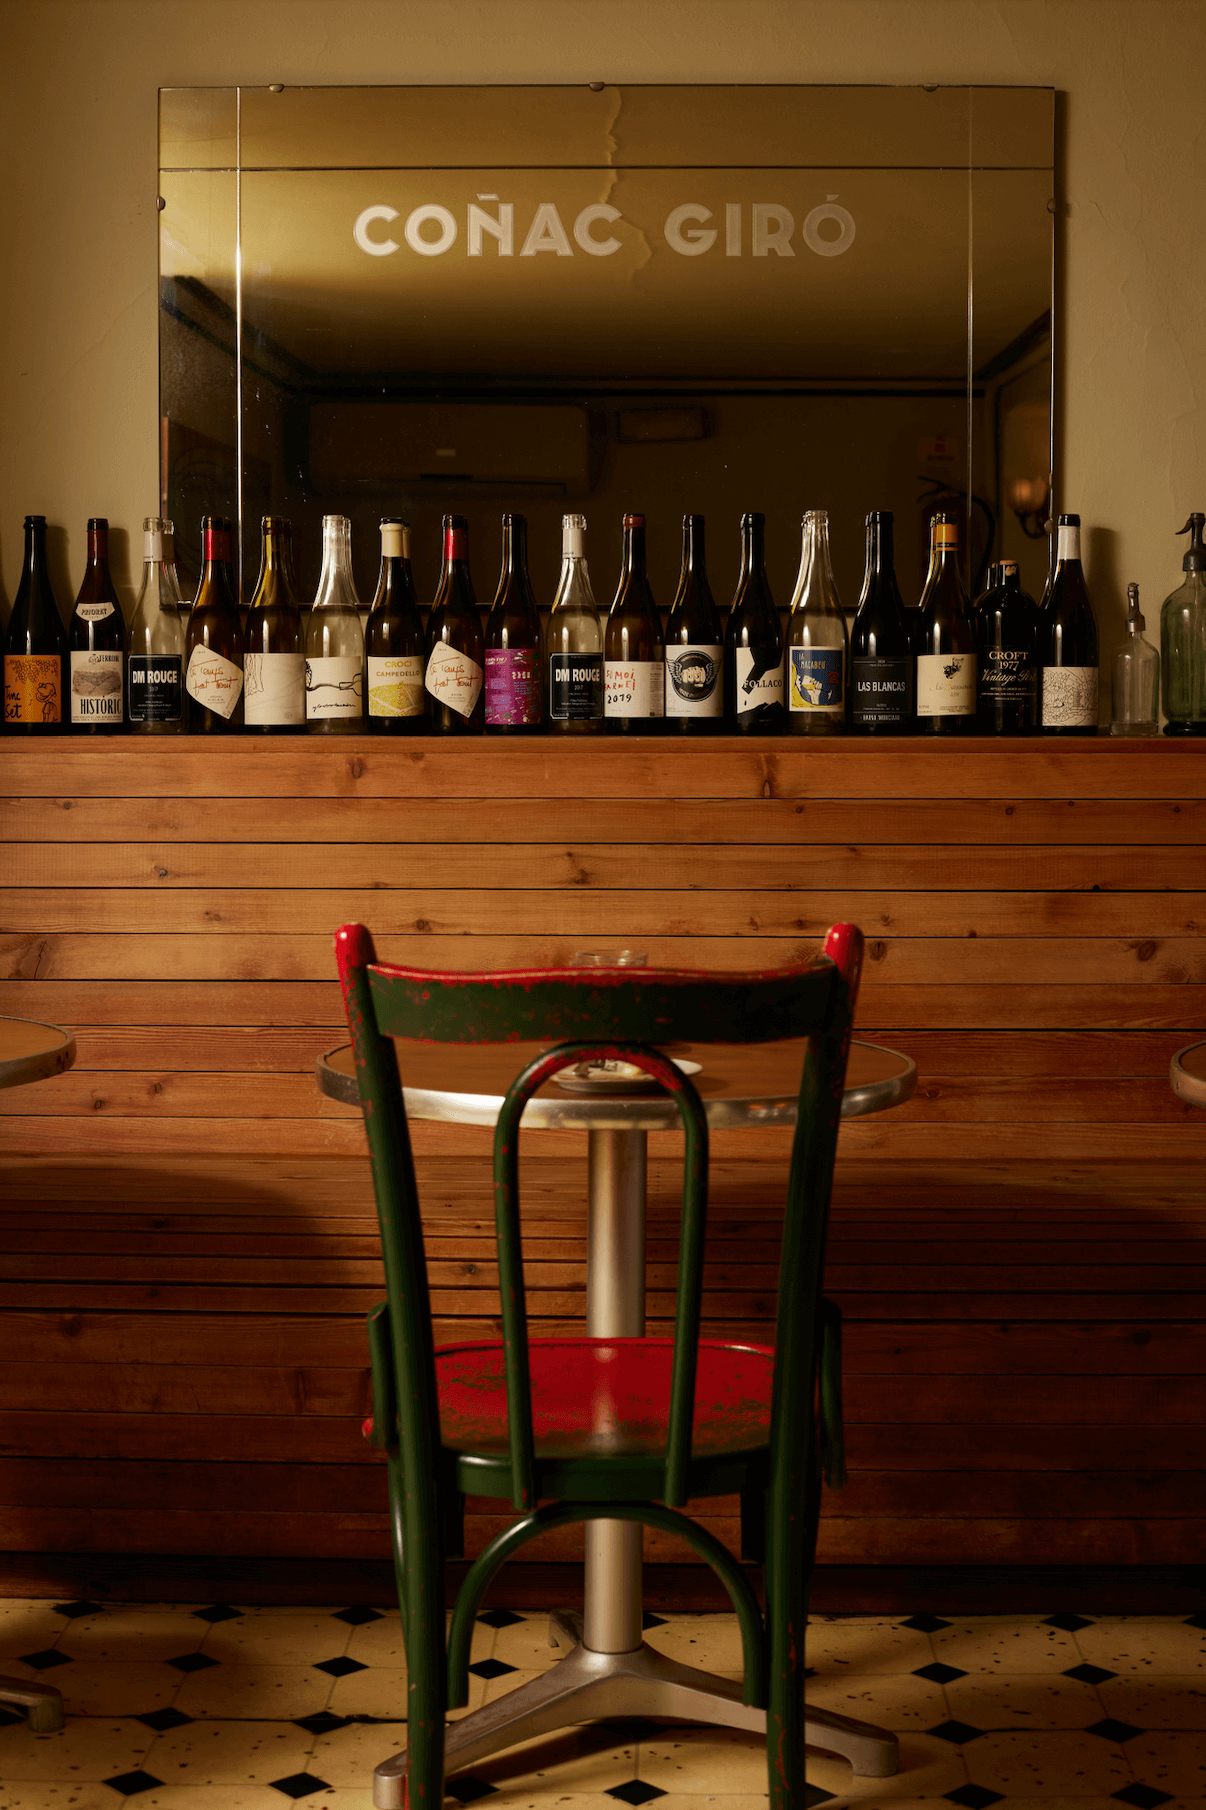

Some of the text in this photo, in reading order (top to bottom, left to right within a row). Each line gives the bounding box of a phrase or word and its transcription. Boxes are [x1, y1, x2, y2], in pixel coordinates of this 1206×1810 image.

[353, 193, 857, 257] COÑAC GIRÓ
[988, 650, 1029, 660] CROFT
[999, 660, 1020, 671] 1977
[132, 670, 178, 684] DM ROUGE
[555, 668, 600, 682] DM ROUGE
[981, 668, 1017, 686] Vintage
[857, 681, 906, 692] LAS BLANCAS
[607, 693, 632, 704] 2019
